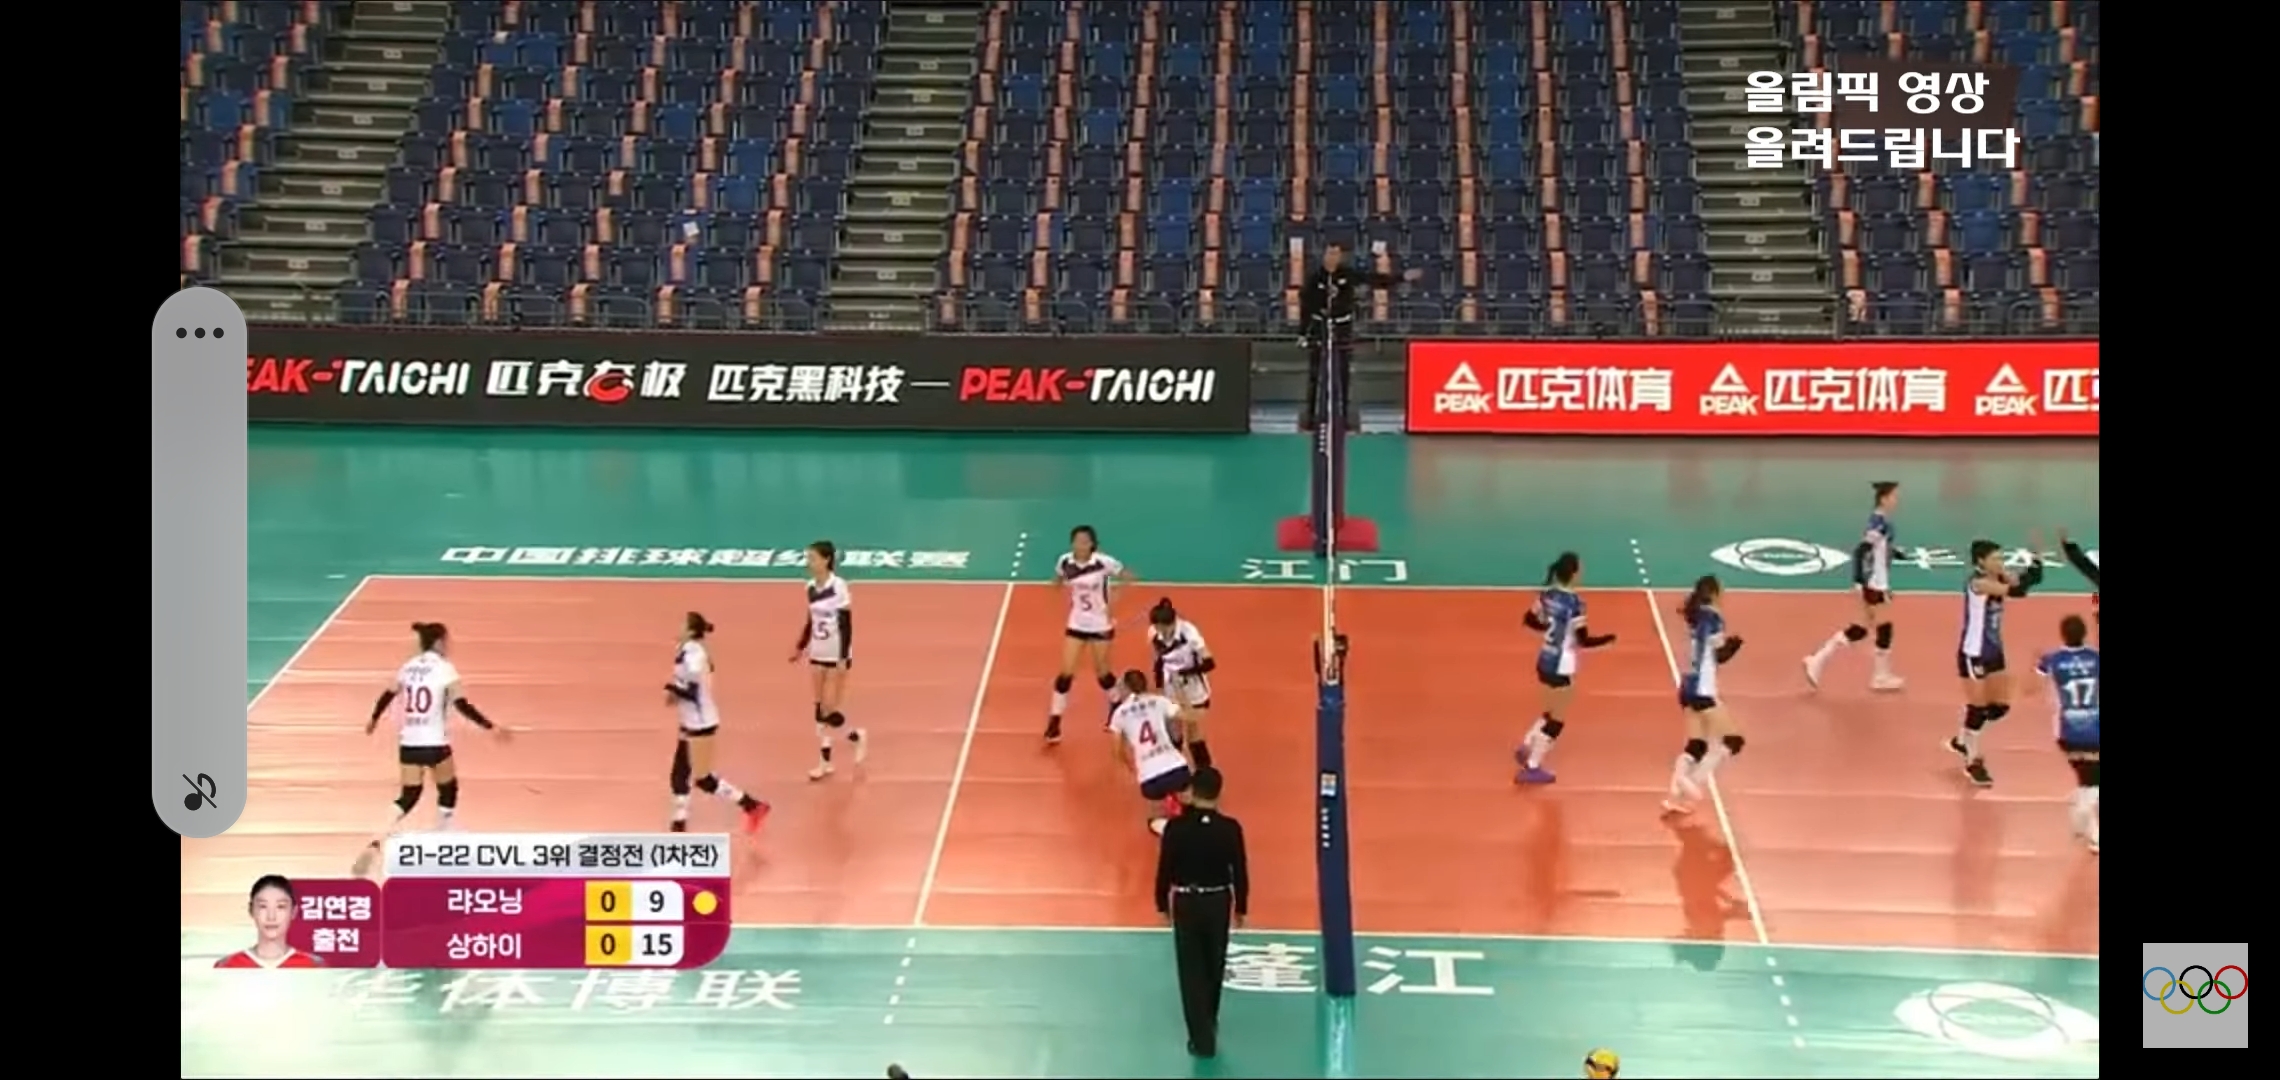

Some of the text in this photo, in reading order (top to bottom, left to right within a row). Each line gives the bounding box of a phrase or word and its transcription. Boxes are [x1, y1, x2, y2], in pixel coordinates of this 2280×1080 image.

[706, 363, 906, 403] 匹克黑科技
[959, 367, 1216, 403] PEAK-TAICHI
[1497, 366, 1673, 412] 匹克体育
[1763, 367, 1948, 413] 匹克体育
[2043, 368, 2099, 412] 匹
[1434, 391, 1494, 414] PEAK
[1699, 394, 1760, 416] PEAK
[1974, 394, 2037, 416] PEAK
[1241, 558, 1408, 581] 江门
[405, 684, 433, 714] 10
[2063, 677, 2096, 706] 17
[1139, 720, 1157, 745] 4
